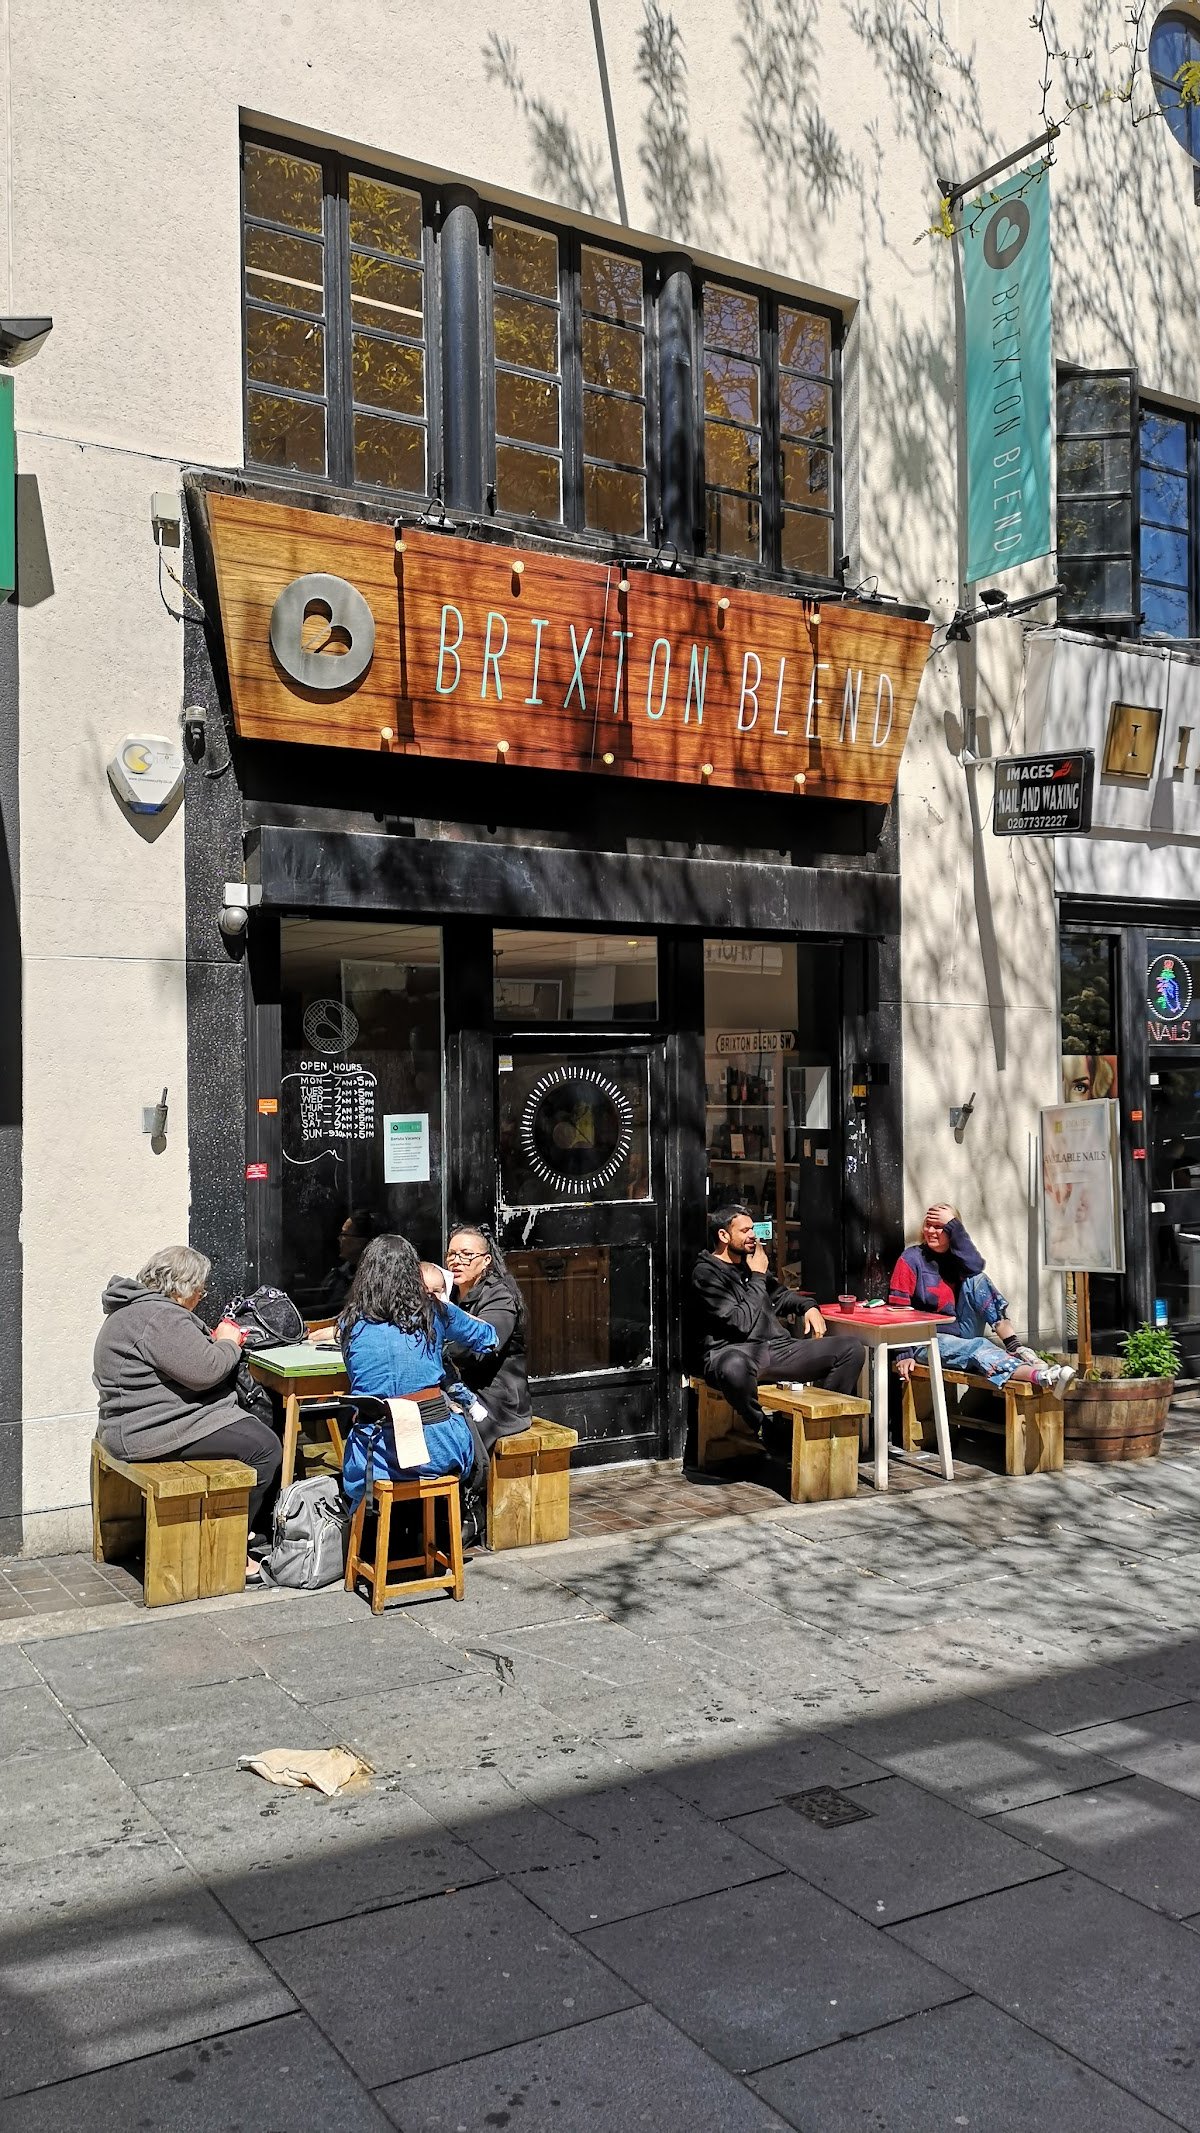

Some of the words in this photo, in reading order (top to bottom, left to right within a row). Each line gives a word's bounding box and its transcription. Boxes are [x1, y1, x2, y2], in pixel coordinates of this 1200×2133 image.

[992, 283, 1022, 438] BRIXTON
[993, 446, 1022, 552] BLEND
[435, 604, 710, 726] BRIXTON
[737, 651, 894, 748] BLEND
[1006, 764, 1054, 782] IMAGES
[998, 788, 1019, 814] NAIL
[1020, 786, 1040, 812] AND
[1042, 782, 1079, 811] WAXING
[1007, 815, 1068, 829] 02077372227
[1147, 1020, 1191, 1041] NAILS
[720, 1035, 751, 1051] BRIXTON
[753, 1034, 777, 1050] BLEND
[300, 1061, 328, 1071] OPEN
[333, 1062, 363, 1071] HOURS
[1082, 1151, 1106, 1162] NAILS
